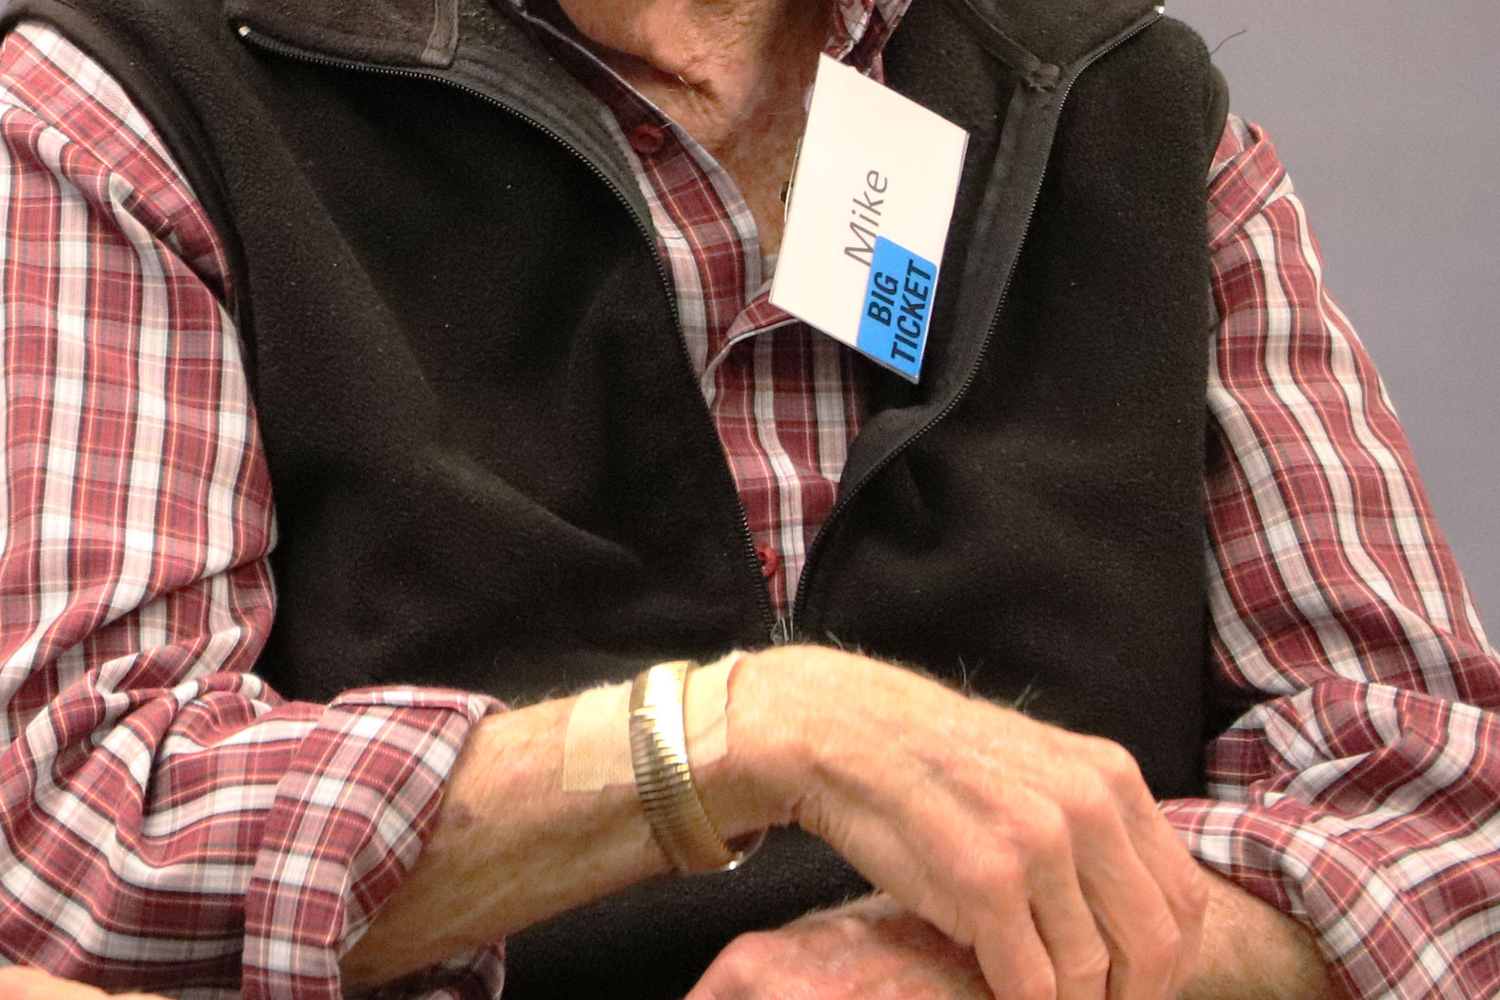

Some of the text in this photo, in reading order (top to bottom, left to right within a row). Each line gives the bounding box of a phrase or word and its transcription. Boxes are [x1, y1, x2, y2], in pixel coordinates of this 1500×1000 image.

[844, 169, 888, 267] Mike
[867, 271, 899, 327] BIG
[890, 258, 932, 363] TICKET
